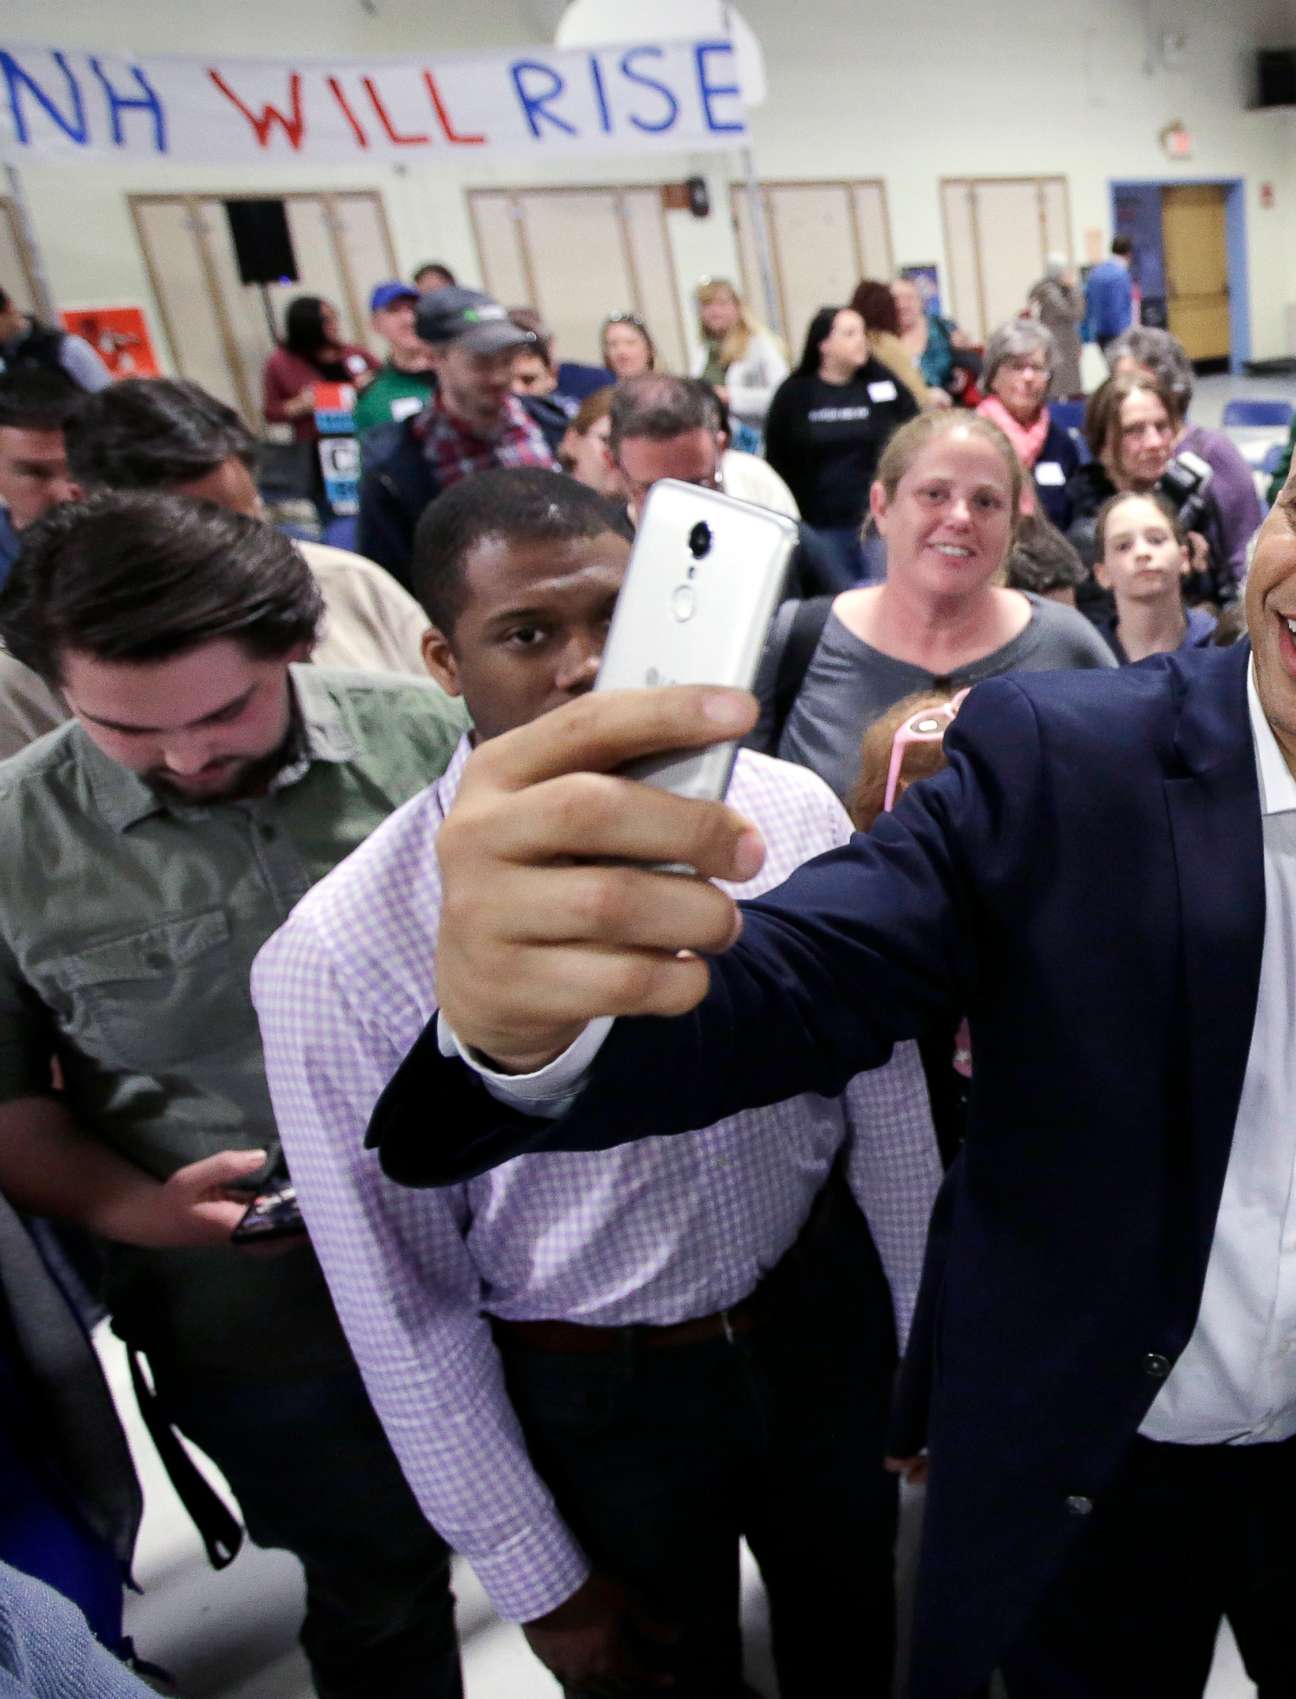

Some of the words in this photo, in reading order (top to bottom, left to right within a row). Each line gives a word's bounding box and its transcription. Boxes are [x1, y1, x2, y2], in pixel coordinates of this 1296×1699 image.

[0, 49, 169, 154] NH
[206, 64, 486, 151] WILL
[510, 43, 745, 138] RISE
